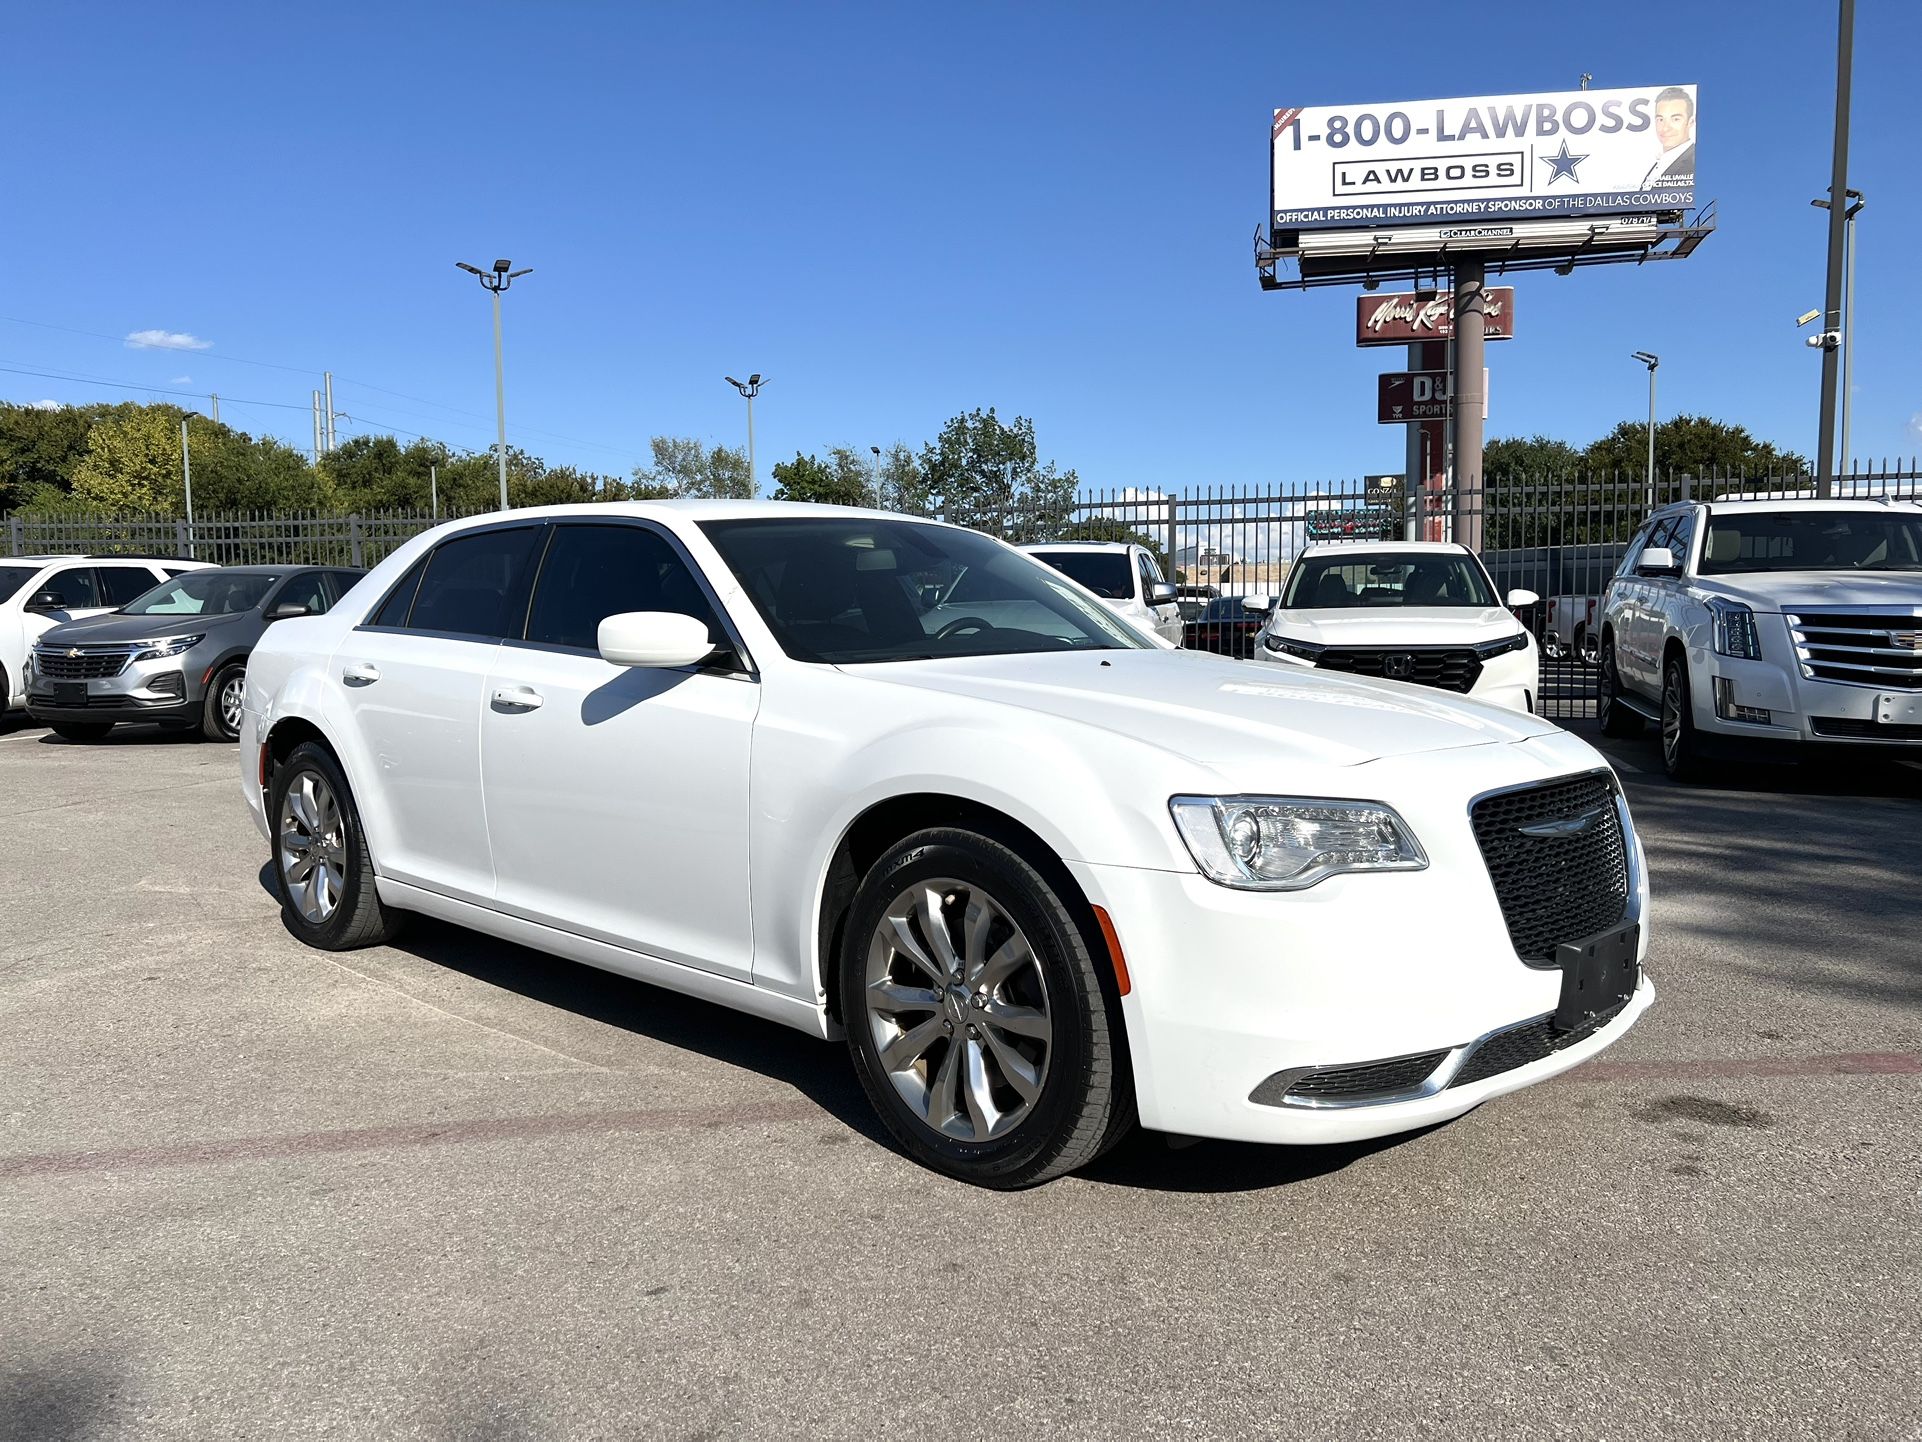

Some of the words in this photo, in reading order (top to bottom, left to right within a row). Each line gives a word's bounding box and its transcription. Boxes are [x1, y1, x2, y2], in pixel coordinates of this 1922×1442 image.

[1287, 98, 1651, 151] 1-800-LAWBOSS
[1341, 162, 1515, 186] LAWBOSS
[1276, 211, 1326, 224] OFFICIAL
[1327, 207, 1386, 221] PERSONAL
[1387, 204, 1427, 218] INJURY
[1428, 201, 1487, 215] ATTORNEY
[1487, 198, 1543, 212] SPONSOR
[1544, 198, 1561, 210] OF
[1562, 197, 1585, 209] THE
[1586, 194, 1630, 208] DALLAS
[1631, 192, 1694, 206] COWBOYS
